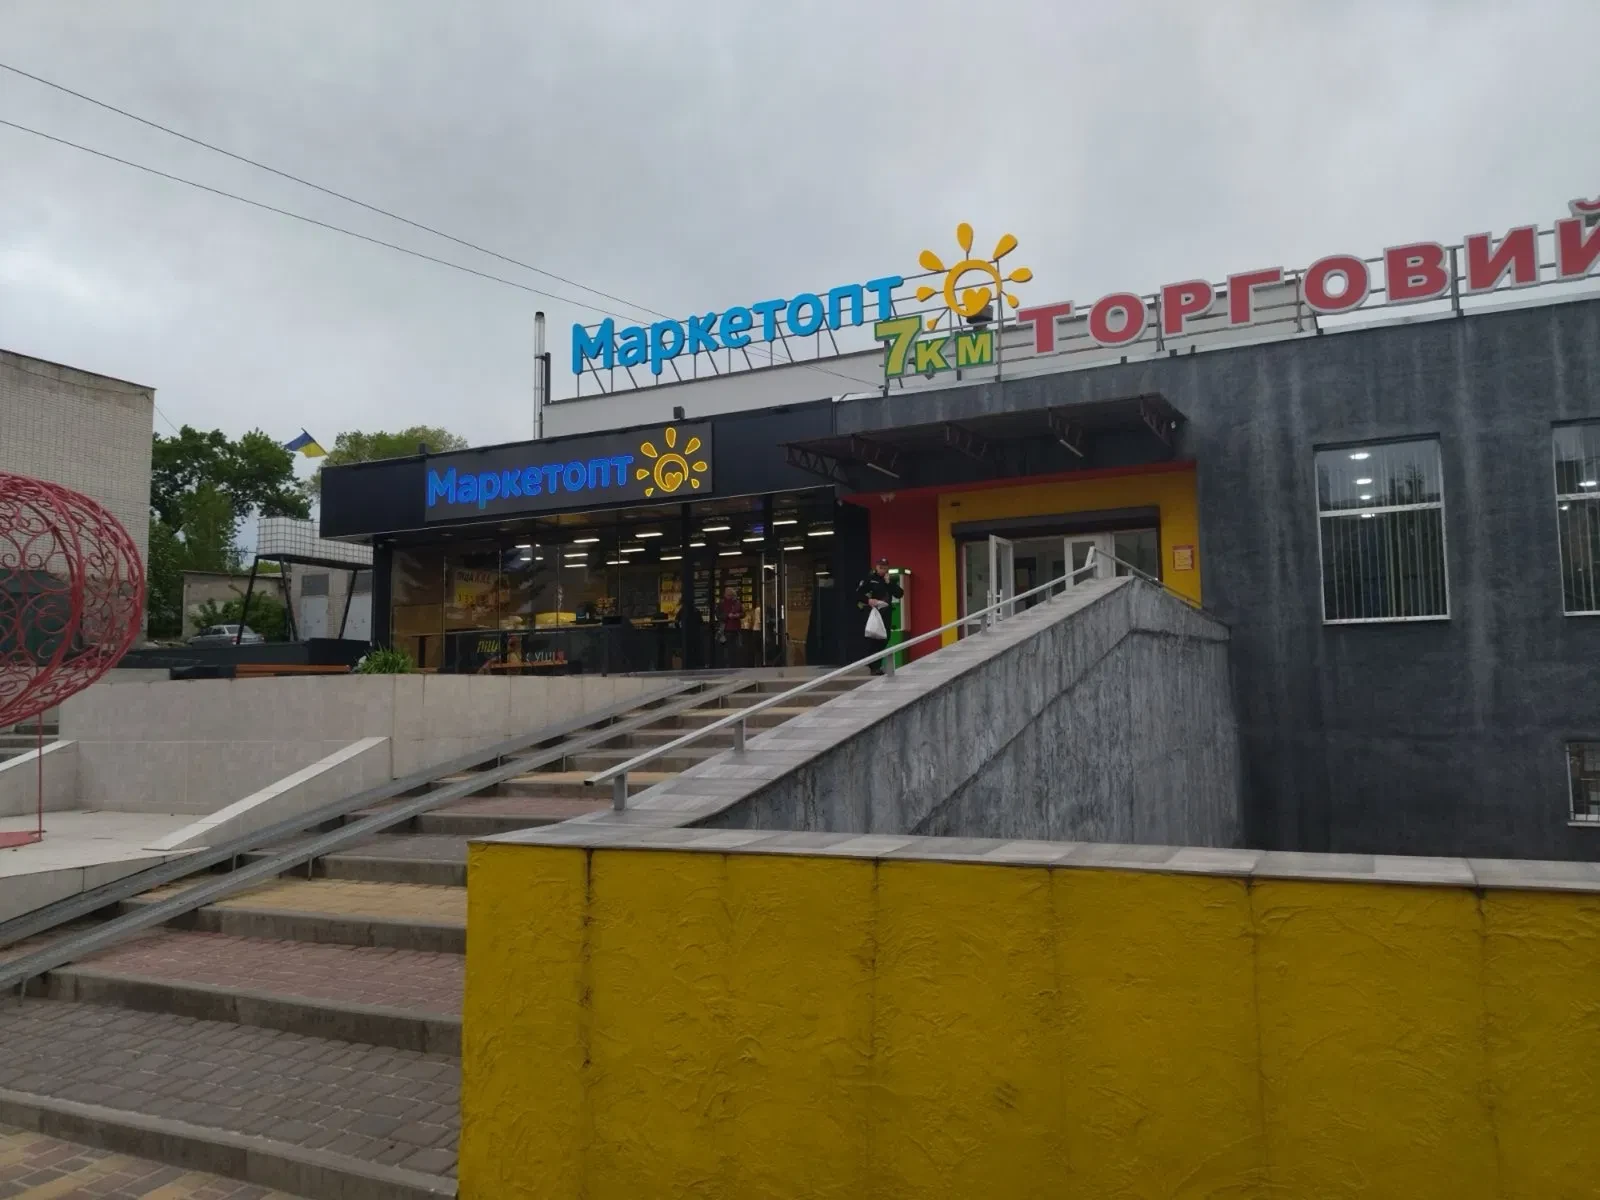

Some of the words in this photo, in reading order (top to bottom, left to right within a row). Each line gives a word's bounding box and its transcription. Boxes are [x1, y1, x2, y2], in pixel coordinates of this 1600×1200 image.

[1016, 194, 1600, 354] ТОРГОВИЙ
[572, 275, 904, 375] Маркетопт
[428, 455, 634, 509] Маркетопт
